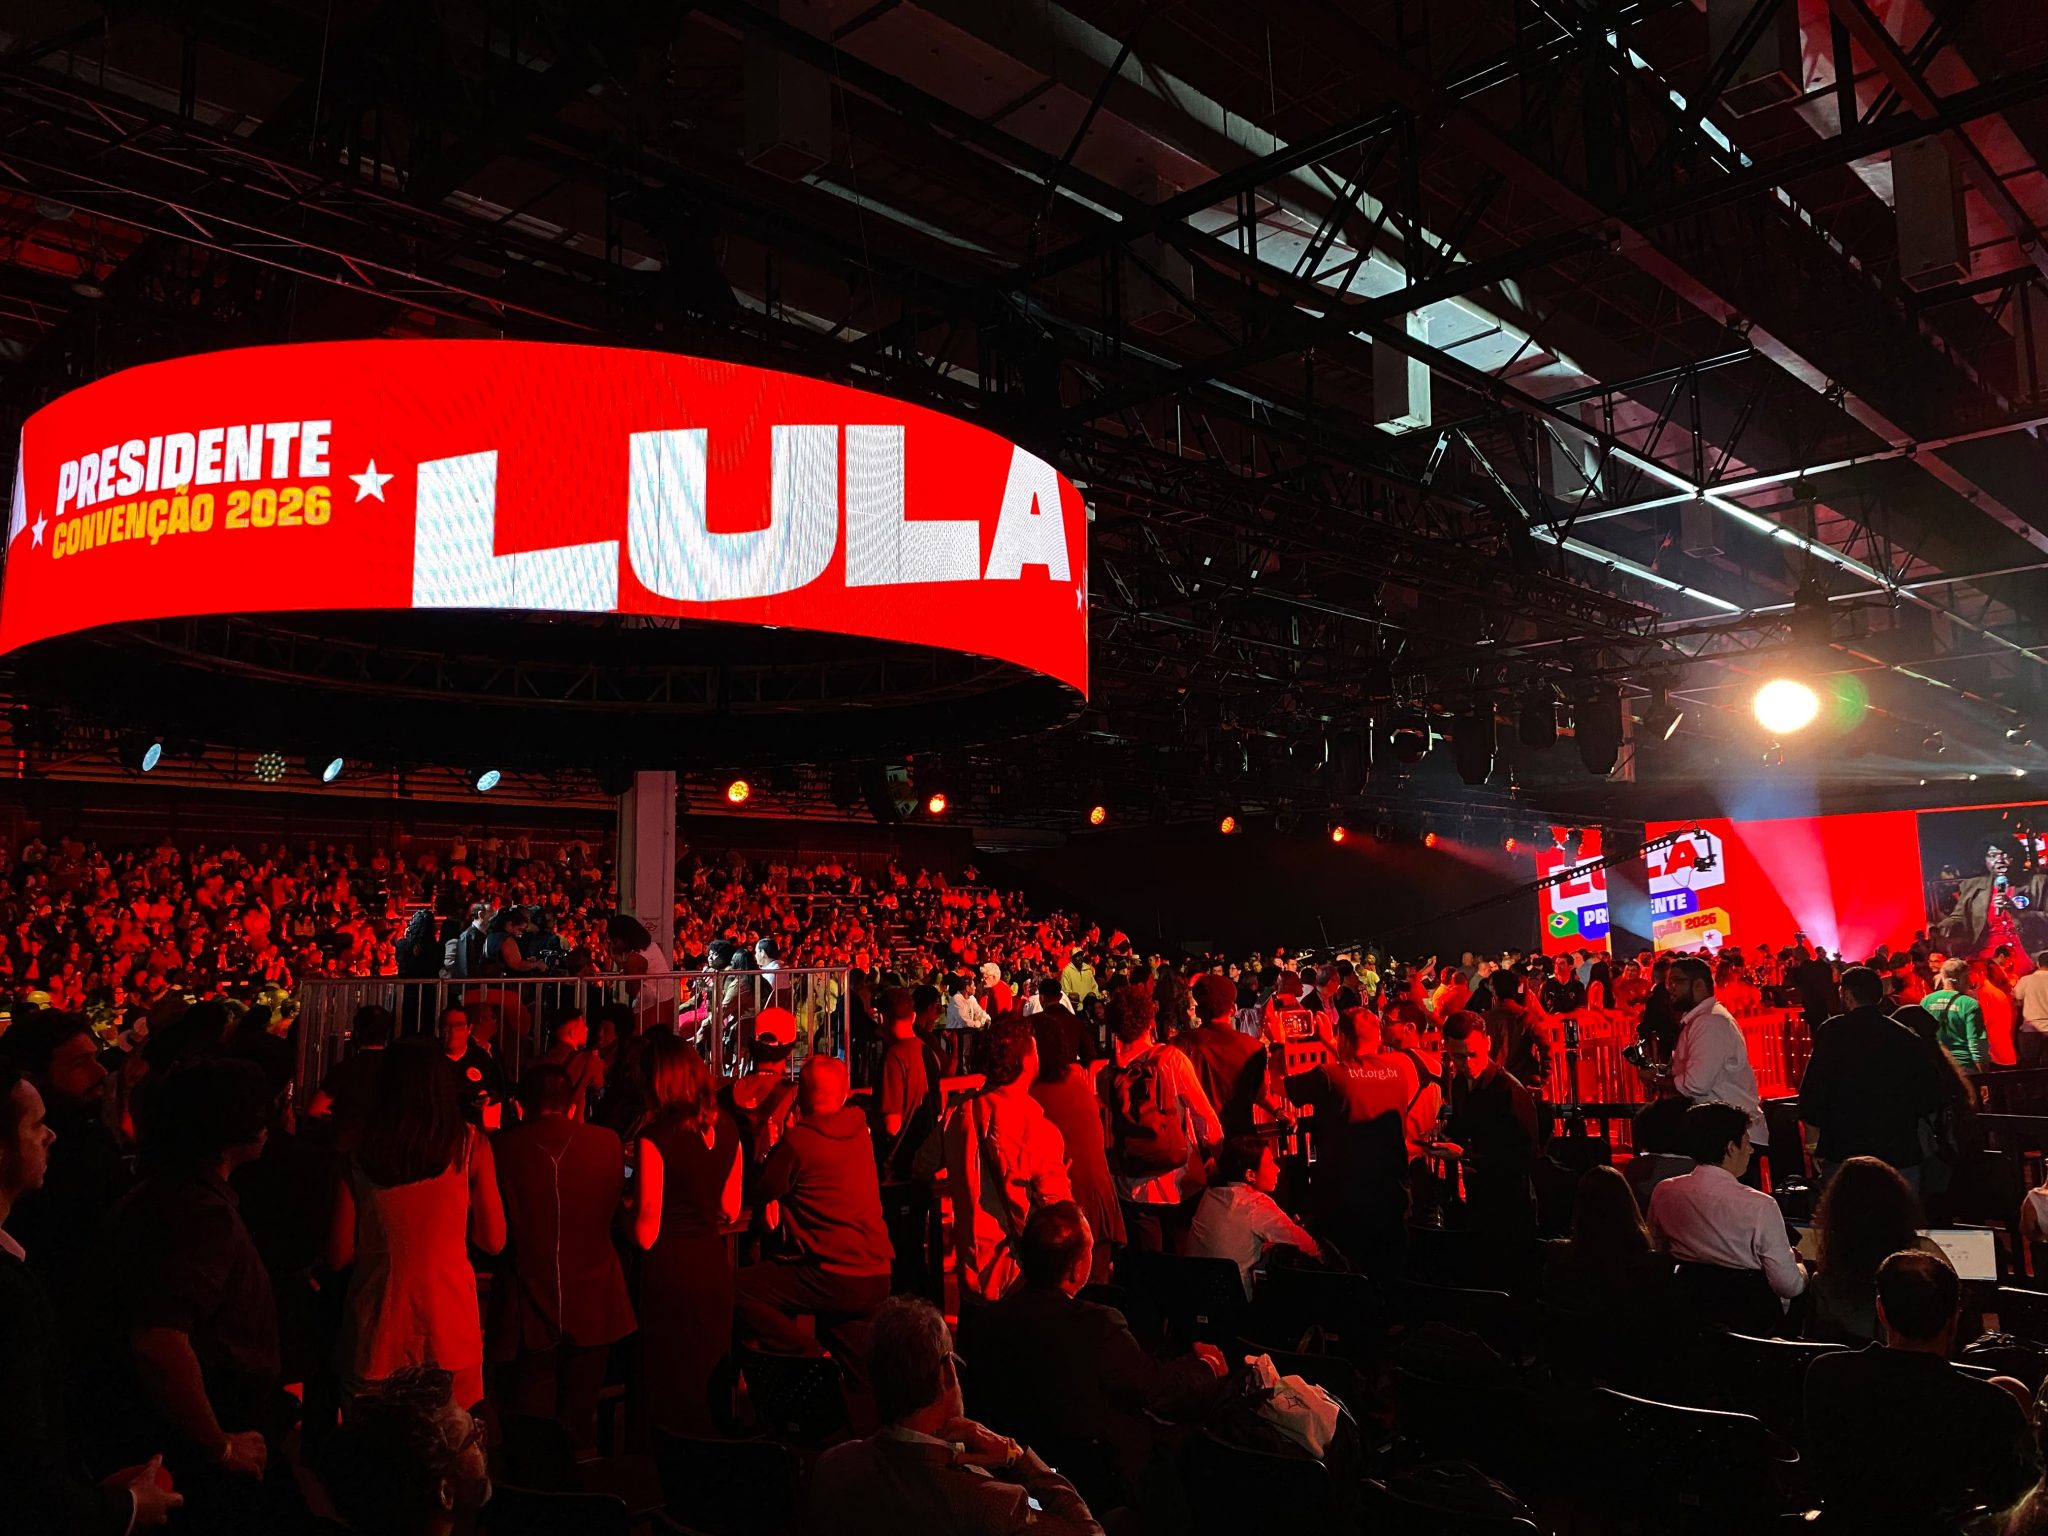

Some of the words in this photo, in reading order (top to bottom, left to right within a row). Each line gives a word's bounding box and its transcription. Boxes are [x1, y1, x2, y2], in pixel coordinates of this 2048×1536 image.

[55, 419, 332, 516] PRESIDENTE
[52, 483, 215, 560] CONVENÇÃO
[225, 486, 331, 530] 2026
[410, 424, 1072, 613] LULA
[1685, 912, 1717, 931] 2026
[1348, 1067, 1399, 1080] tvt.org.br
